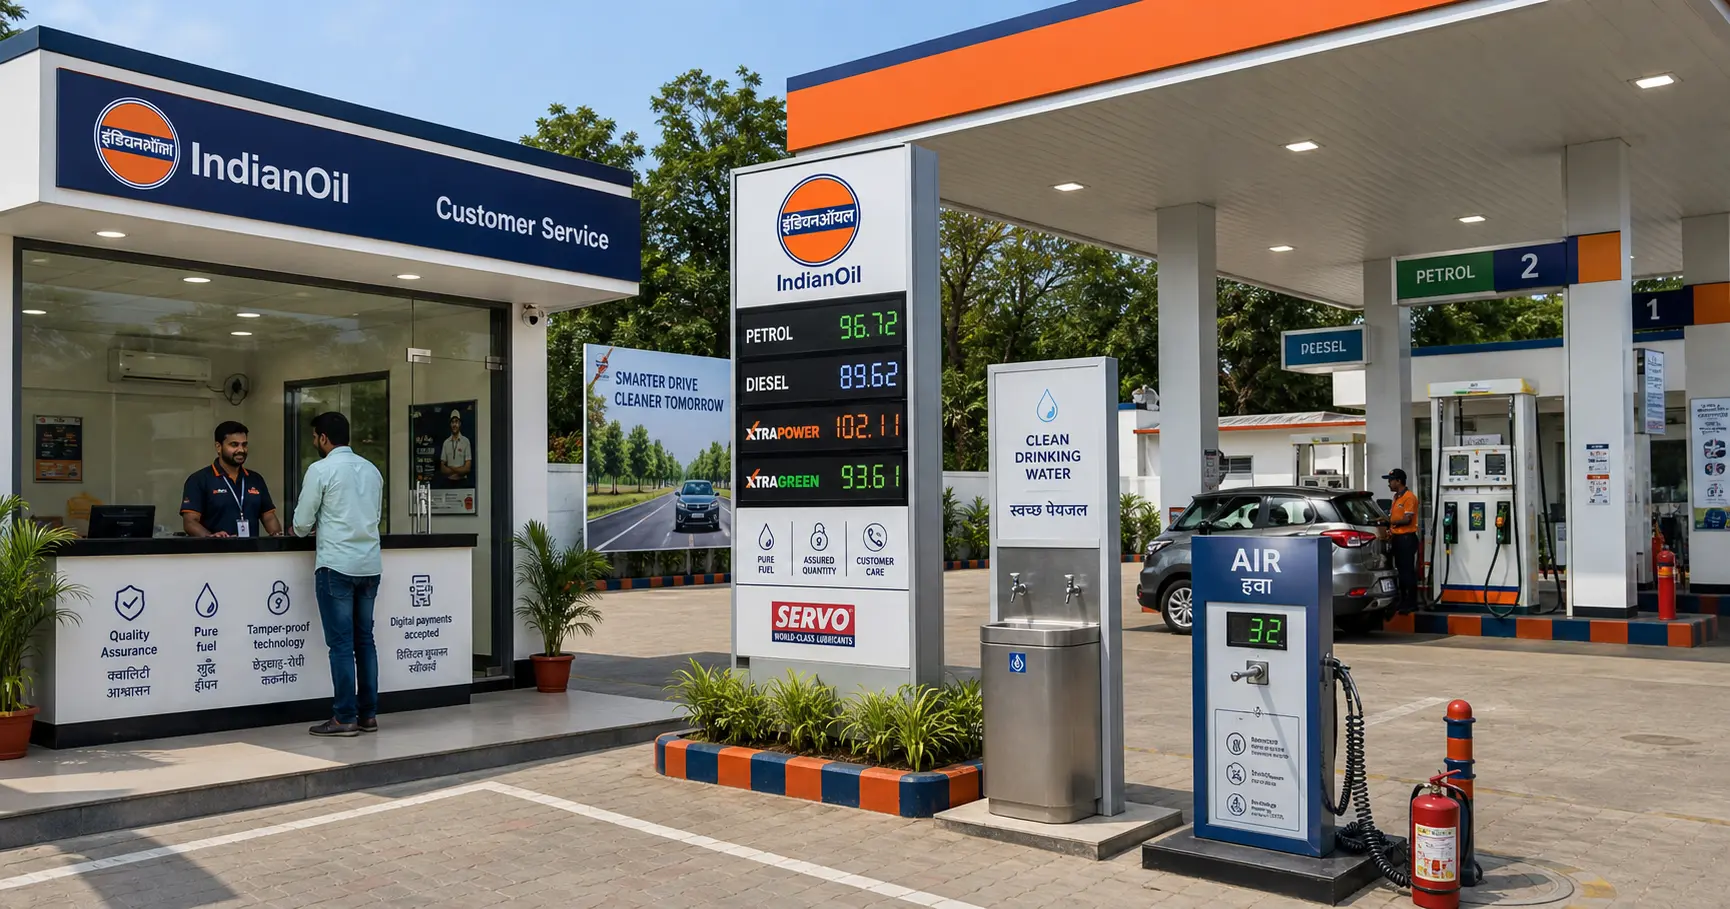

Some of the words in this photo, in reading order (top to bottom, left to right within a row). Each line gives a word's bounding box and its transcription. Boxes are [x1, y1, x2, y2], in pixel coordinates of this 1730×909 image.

[191, 141, 349, 204] IndianOil
[436, 195, 536, 236] Customer
[541, 216, 609, 250] Service
[1416, 265, 1475, 284] PETROL
[1521, 253, 1539, 279] 2
[777, 265, 861, 292] IndianOil
[1646, 298, 1660, 321] 1
[746, 325, 793, 344] PETROL
[840, 310, 898, 340] 96.72
[615, 370, 665, 389] SMARTER
[668, 376, 698, 392] DRIVE
[746, 375, 789, 393] DIESEL
[840, 361, 898, 390] 89.62
[614, 391, 662, 409] CLEANER
[664, 395, 724, 413] TOMORROW
[745, 421, 820, 441] XTRAPOWER
[836, 413, 900, 439] 102.11
[1025, 433, 1070, 447] CLEAN
[1014, 449, 1082, 465] DRINKING
[745, 468, 820, 489] XTRAGREEN
[841, 464, 900, 490] 93.61
[1025, 467, 1071, 480] WATER
[1009, 504, 1042, 516] स्वच्छ
[1045, 500, 1088, 516] पेयजल
[757, 555, 775, 565] PURE
[803, 555, 835, 565] ASSURED
[856, 556, 895, 566] CUSTOMER
[1231, 548, 1282, 573] AIR
[758, 565, 775, 575] FUEL
[802, 566, 837, 576] QUANTITY
[865, 567, 885, 577] CARE
[1240, 578, 1273, 595] हवा
[390, 616, 414, 628] Digital
[416, 614, 452, 627] payments
[775, 605, 850, 631] SERVO
[109, 629, 150, 643] Quality
[194, 626, 219, 637] Pure
[247, 621, 310, 636] Tamper-proof
[404, 628, 440, 640] accepted
[1249, 618, 1281, 643] 32
[196, 640, 217, 652] fuel
[253, 637, 305, 649] technology
[774, 632, 815, 643] WORLD-CLASS
[816, 635, 853, 645] LUBRICANTS
[100, 646, 158, 658] Assurance
